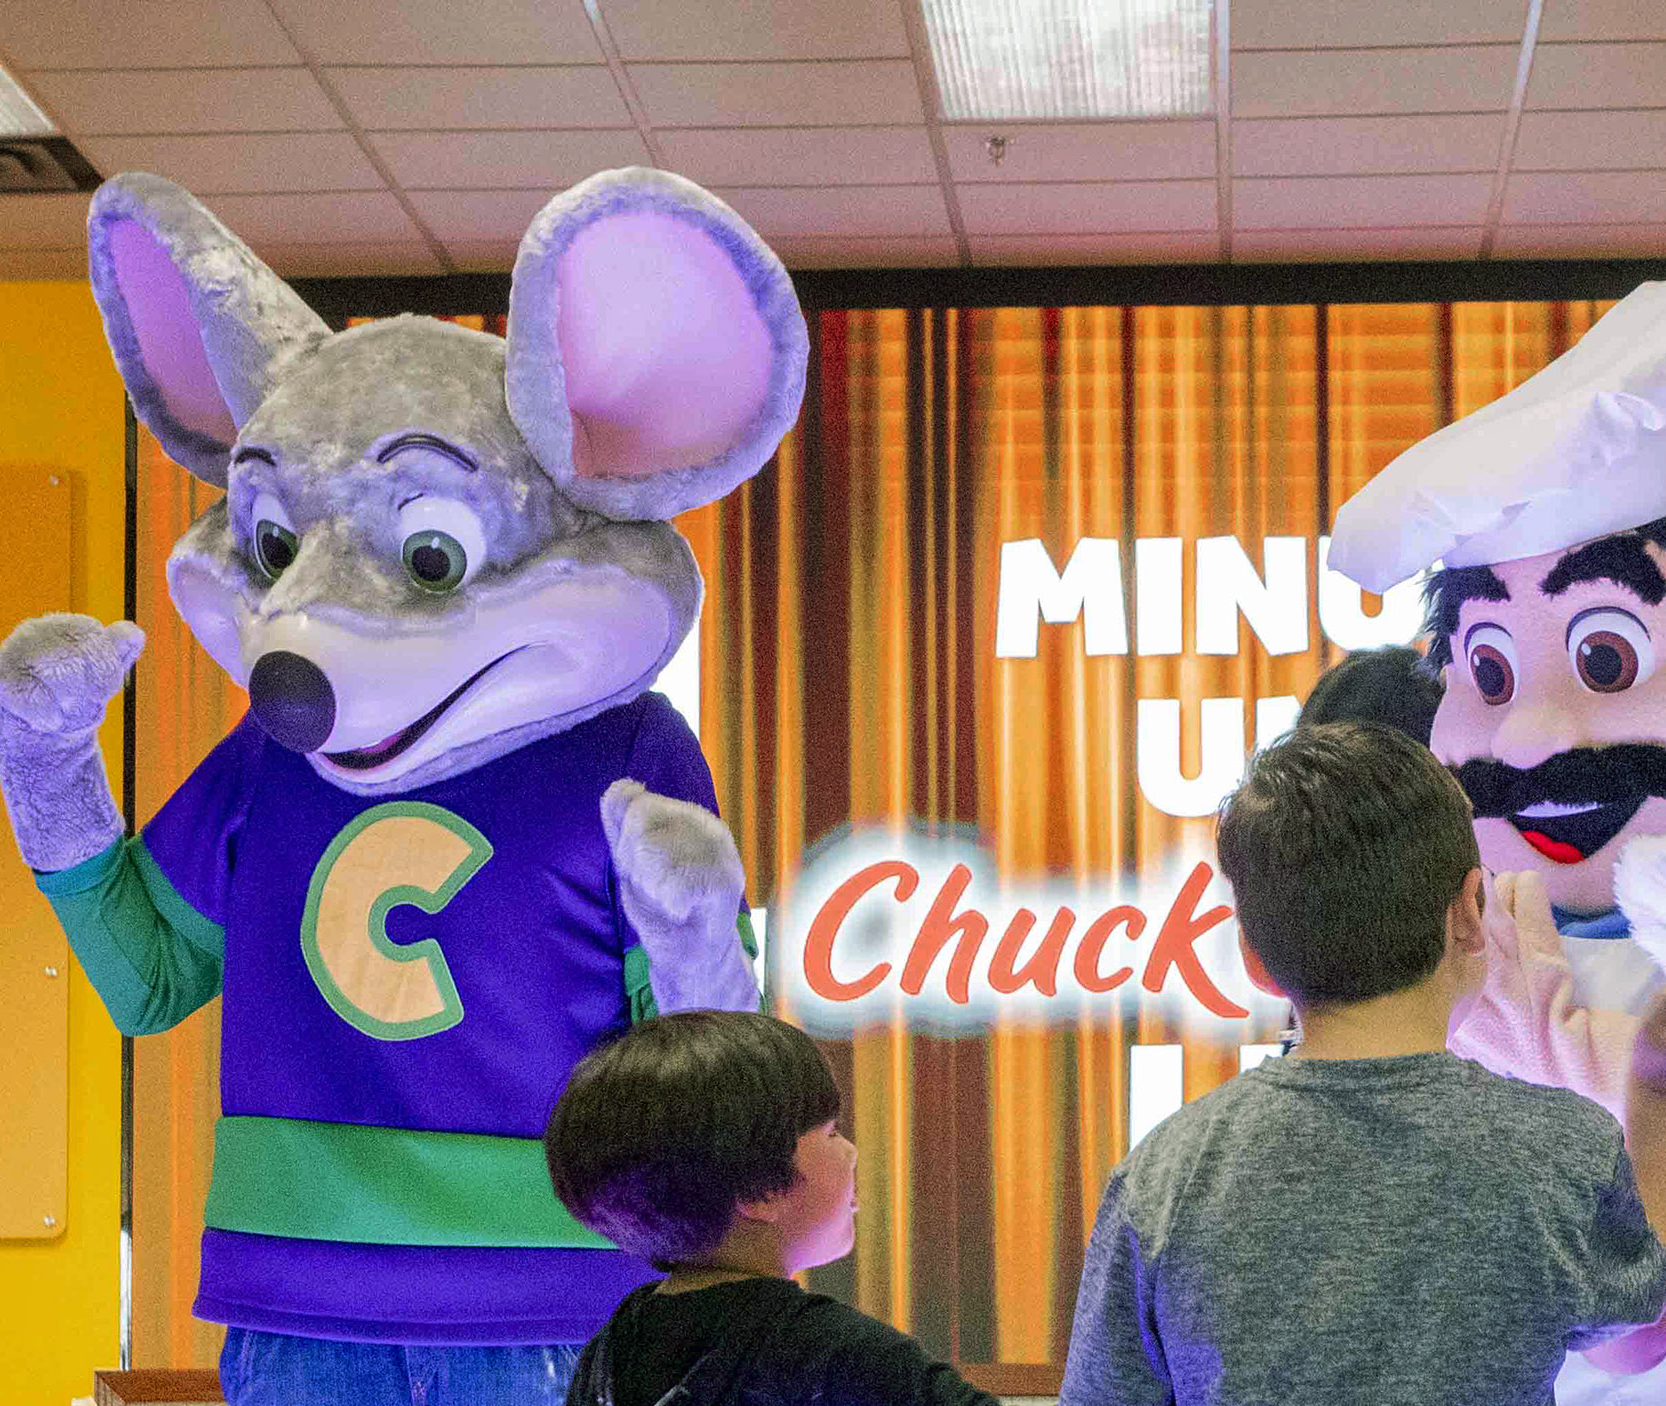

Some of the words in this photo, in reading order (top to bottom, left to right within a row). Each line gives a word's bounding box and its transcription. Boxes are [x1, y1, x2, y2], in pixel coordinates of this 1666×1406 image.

[996, 534, 1443, 660] MINU
[300, 800, 494, 1041] C
[802, 858, 1251, 1019] Chuck
